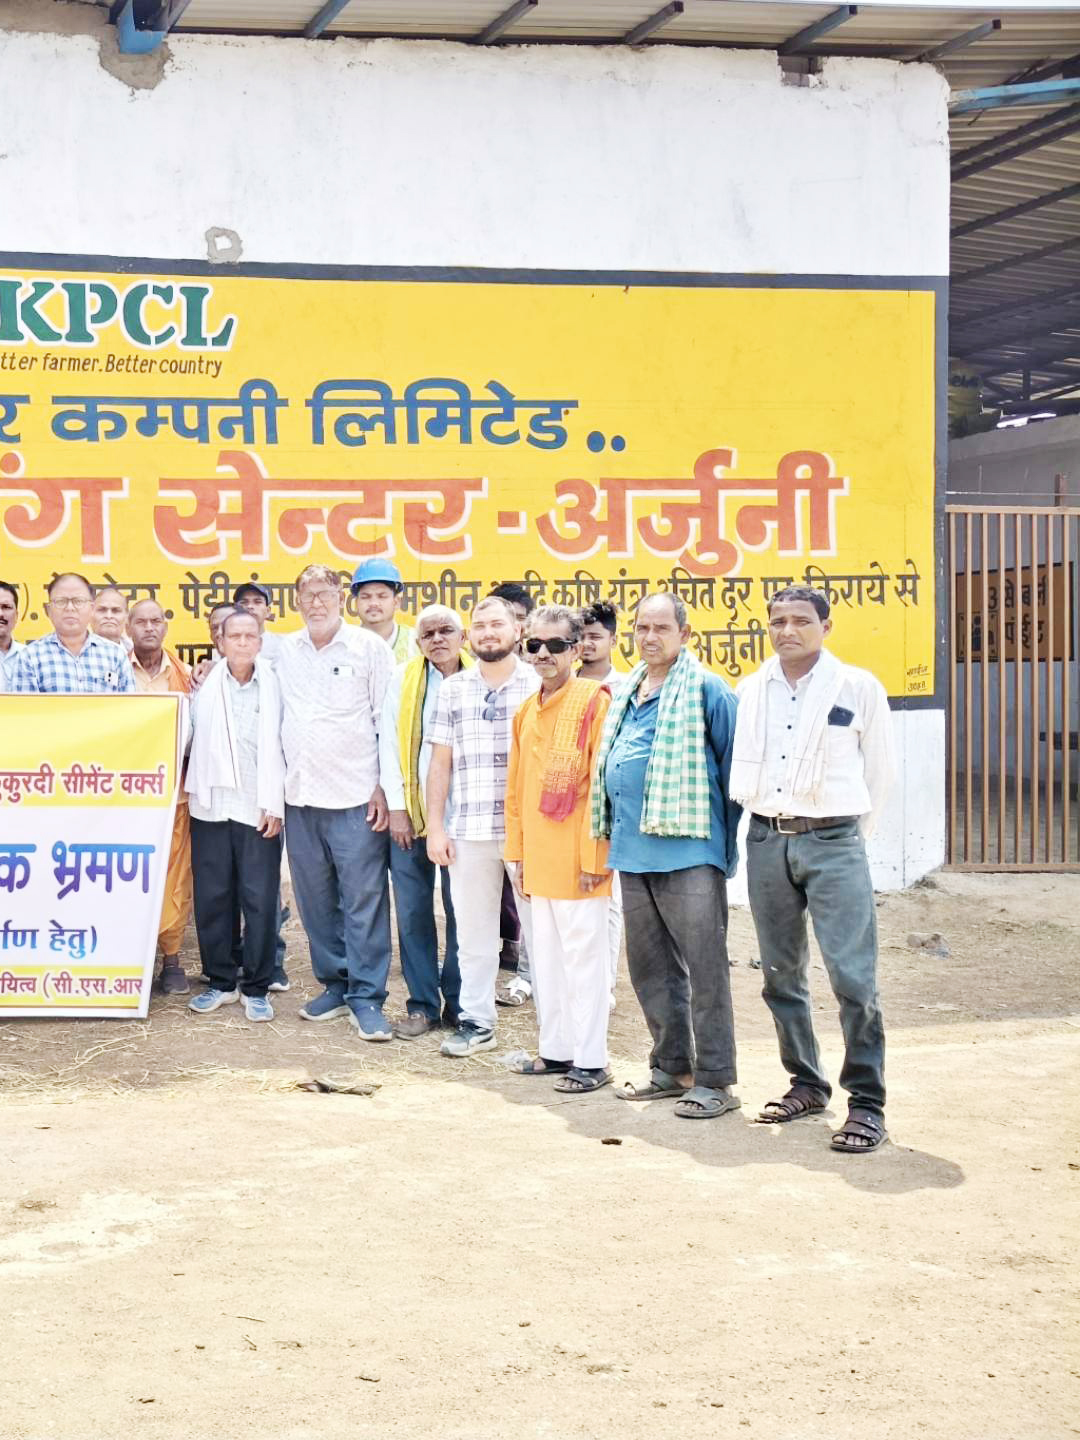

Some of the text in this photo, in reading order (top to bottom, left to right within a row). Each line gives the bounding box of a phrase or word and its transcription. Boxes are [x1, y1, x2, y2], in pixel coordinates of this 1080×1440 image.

[105, 353, 157, 373] Better
[159, 355, 222, 378] country
[51, 377, 289, 446] कम्पनी
[153, 449, 489, 564] सेन्टर
[535, 446, 851, 579] अर्जुनी
[721, 577, 754, 621] दर
[894, 558, 921, 608] से
[62, 764, 115, 796] सीमेंट
[121, 764, 165, 796] वर्क्स
[51, 840, 156, 900] भ्रमण
[48, 918, 98, 960] हेतु)
